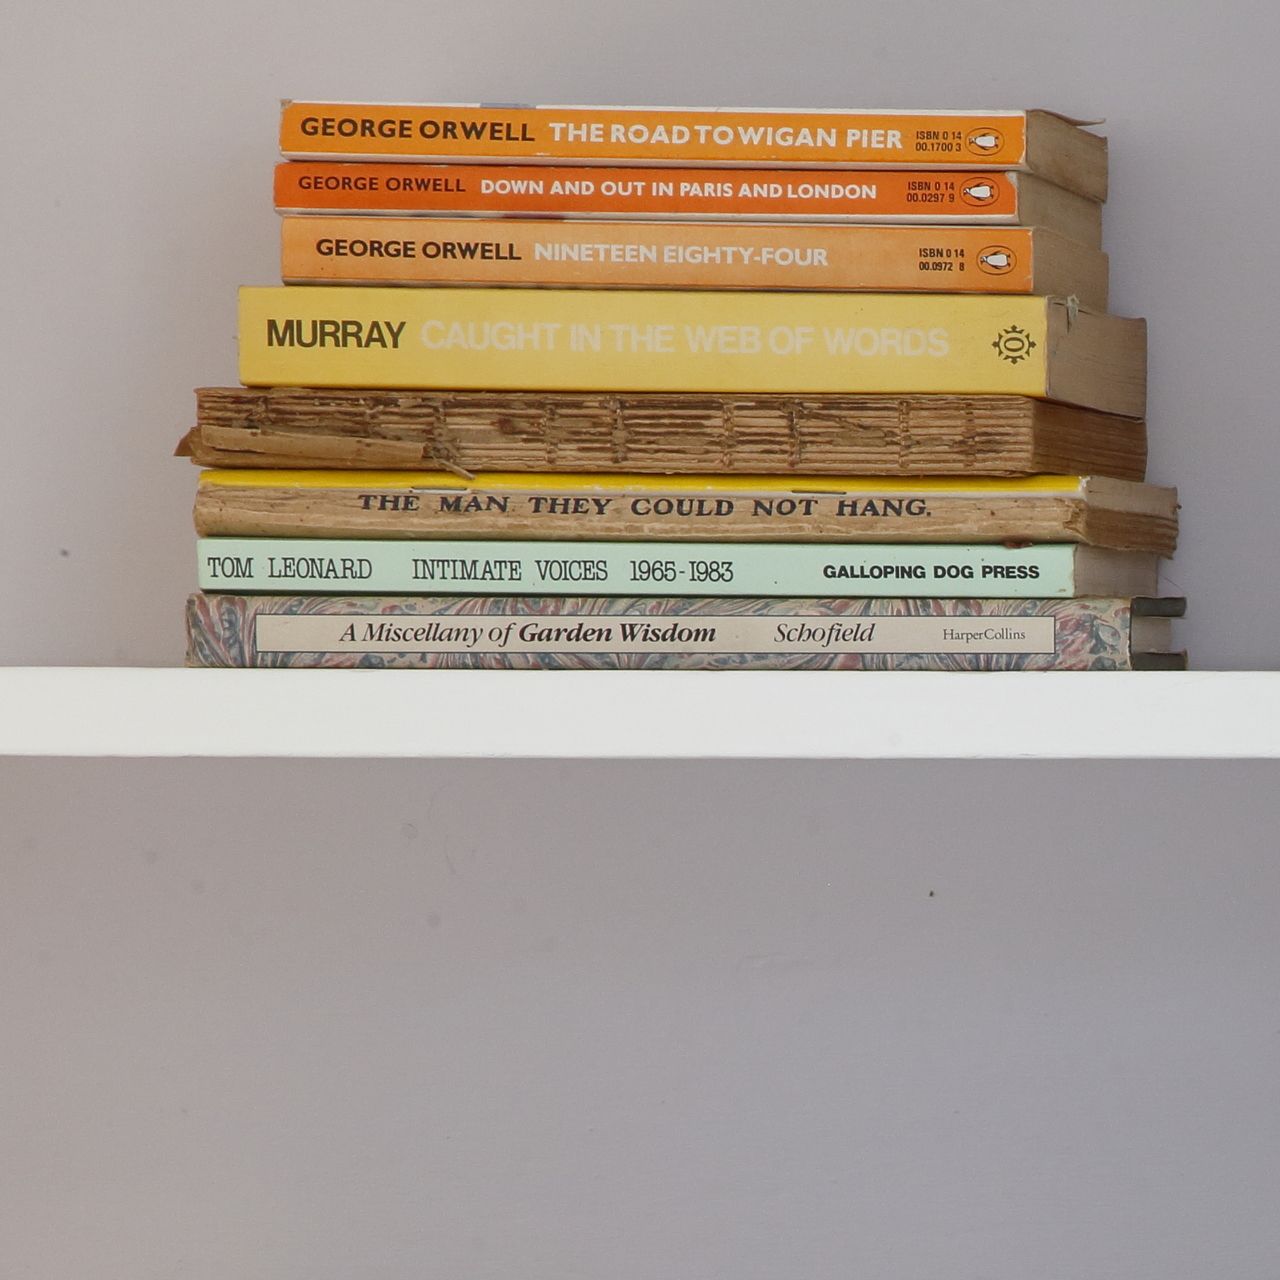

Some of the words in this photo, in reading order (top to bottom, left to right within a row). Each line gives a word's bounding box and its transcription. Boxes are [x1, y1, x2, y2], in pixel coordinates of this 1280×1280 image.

[300, 116, 412, 139] GEORGE
[418, 119, 535, 142] ORWELL
[549, 121, 604, 143] THE
[609, 123, 690, 145] ROAD
[694, 126, 737, 146] TO
[738, 126, 837, 148] WIGAN
[845, 128, 903, 150] PIER
[916, 131, 939, 140] ISBN
[952, 131, 962, 140] 14
[915, 142, 953, 152] 00.1700
[955, 142, 962, 152] 3
[298, 175, 379, 192] GEORGE
[385, 176, 466, 193] ORWELL
[480, 178, 544, 195] DOWN
[549, 179, 595, 196] AND
[600, 180, 645, 197] OUT
[651, 181, 673, 198] IN
[680, 182, 733, 199] PARIS
[737, 182, 783, 200] AND
[786, 183, 878, 200] LONDON
[907, 181, 931, 191] ISBN
[944, 182, 955, 191] 14
[315, 238, 416, 259] GEORGE
[421, 240, 522, 262] ORWELL
[534, 242, 658, 264] NINETEEN
[662, 245, 829, 267] EIGHTY-FOUR
[918, 248, 943, 258] ISBN
[954, 248, 965, 258] 14
[918, 262, 953, 272] 00.0972
[959, 262, 965, 272] 8
[265, 319, 407, 350] MURRAY
[418, 319, 563, 353] CAUGHT
[569, 324, 602, 353] IN
[610, 324, 676, 354] THE
[684, 325, 763, 355] WEB
[768, 326, 815, 356] OF
[824, 327, 949, 358] WORDS
[358, 494, 420, 512] THE
[439, 495, 510, 514] MAN
[528, 496, 614, 517] THEY
[630, 497, 735, 518] COULD
[751, 498, 818, 517] NOT
[835, 497, 933, 518] HANG.
[207, 556, 253, 579] TOM
[268, 557, 373, 581] LEONARD
[412, 558, 523, 582] INTIMATE
[535, 559, 609, 583] VOICES
[823, 564, 926, 580] GALLOPING
[933, 564, 974, 580] DOG
[981, 564, 1040, 580] PRESS
[339, 624, 358, 642] A
[362, 621, 485, 649] Miscellany
[488, 621, 513, 649] of
[518, 622, 614, 644] Garden
[621, 622, 717, 644] Wisdom
[773, 622, 876, 648] Schofield
[942, 627, 1026, 642] HarperCollins
